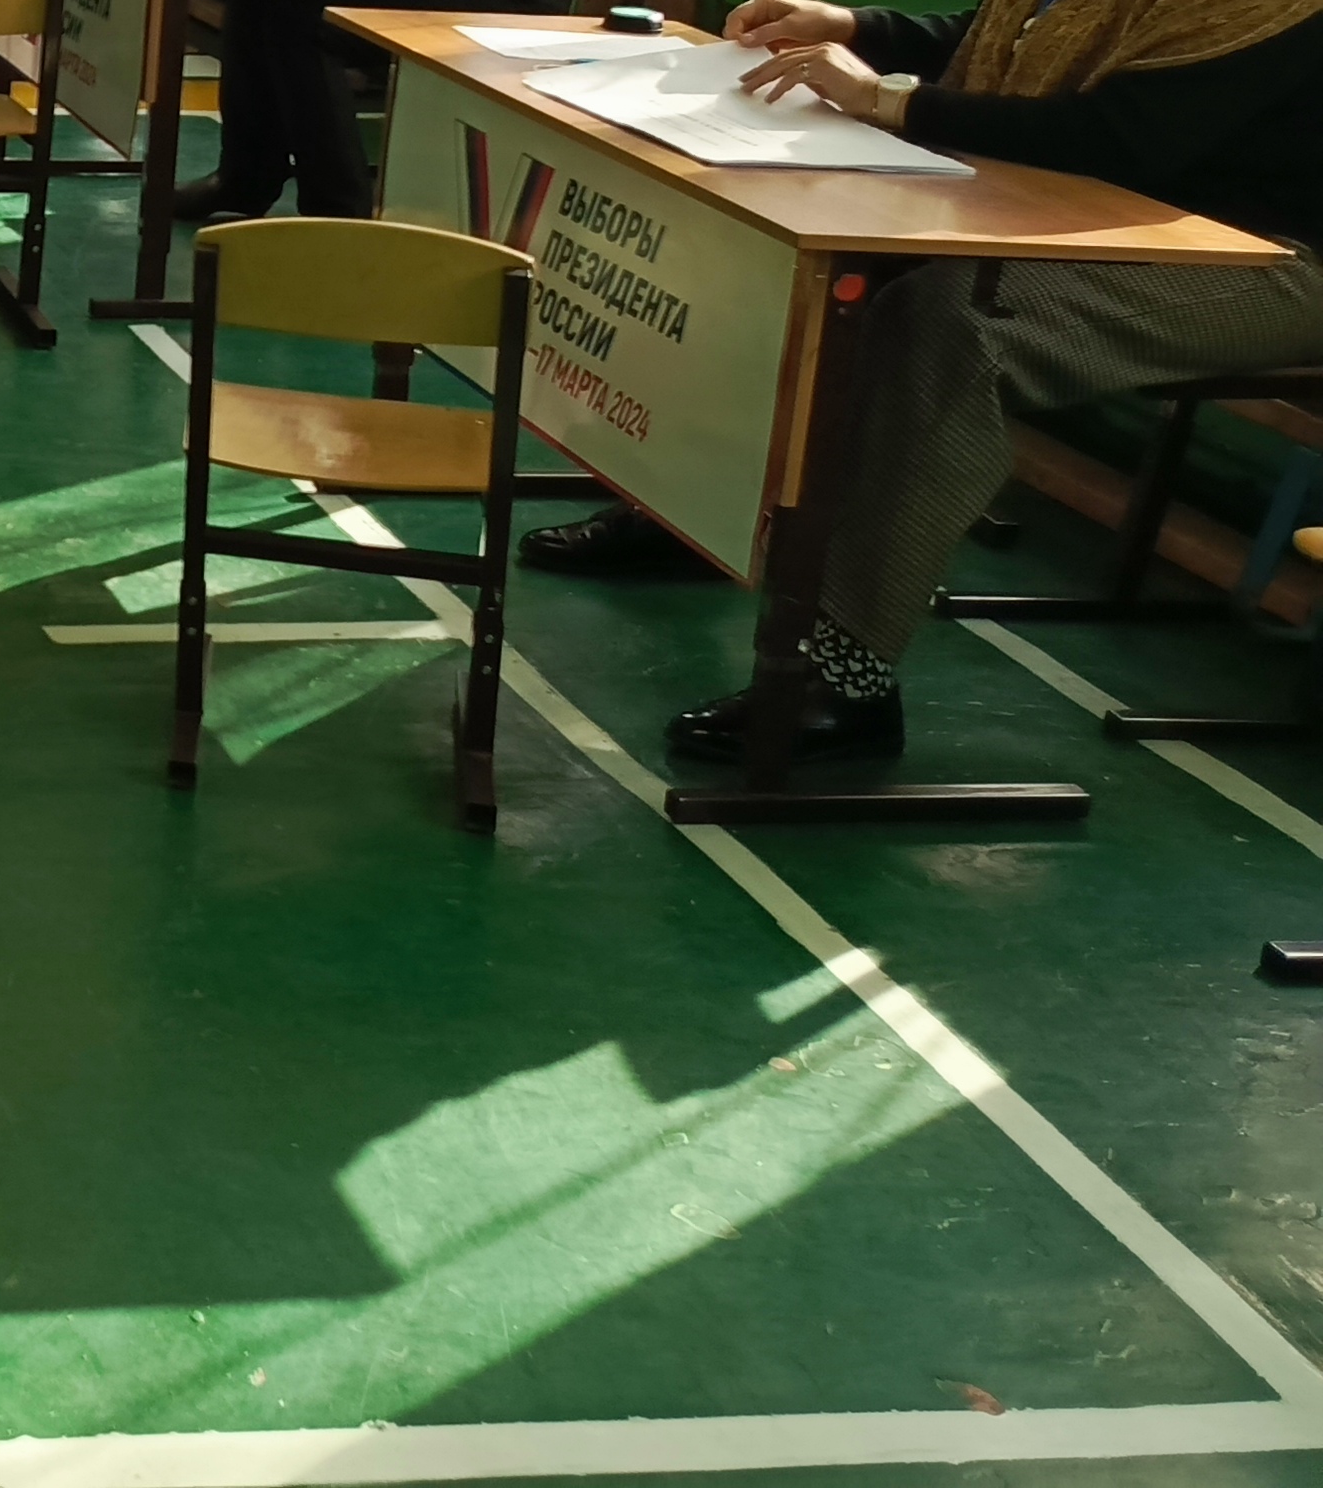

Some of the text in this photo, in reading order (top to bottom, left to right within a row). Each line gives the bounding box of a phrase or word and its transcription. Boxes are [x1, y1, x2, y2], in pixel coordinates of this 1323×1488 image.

[558, 178, 666, 262] ВЫБОРЫ
[542, 229, 690, 344] ПРЕЗИДЕНТА
[551, 355, 610, 415] МАРТА
[606, 391, 652, 442] 2024
